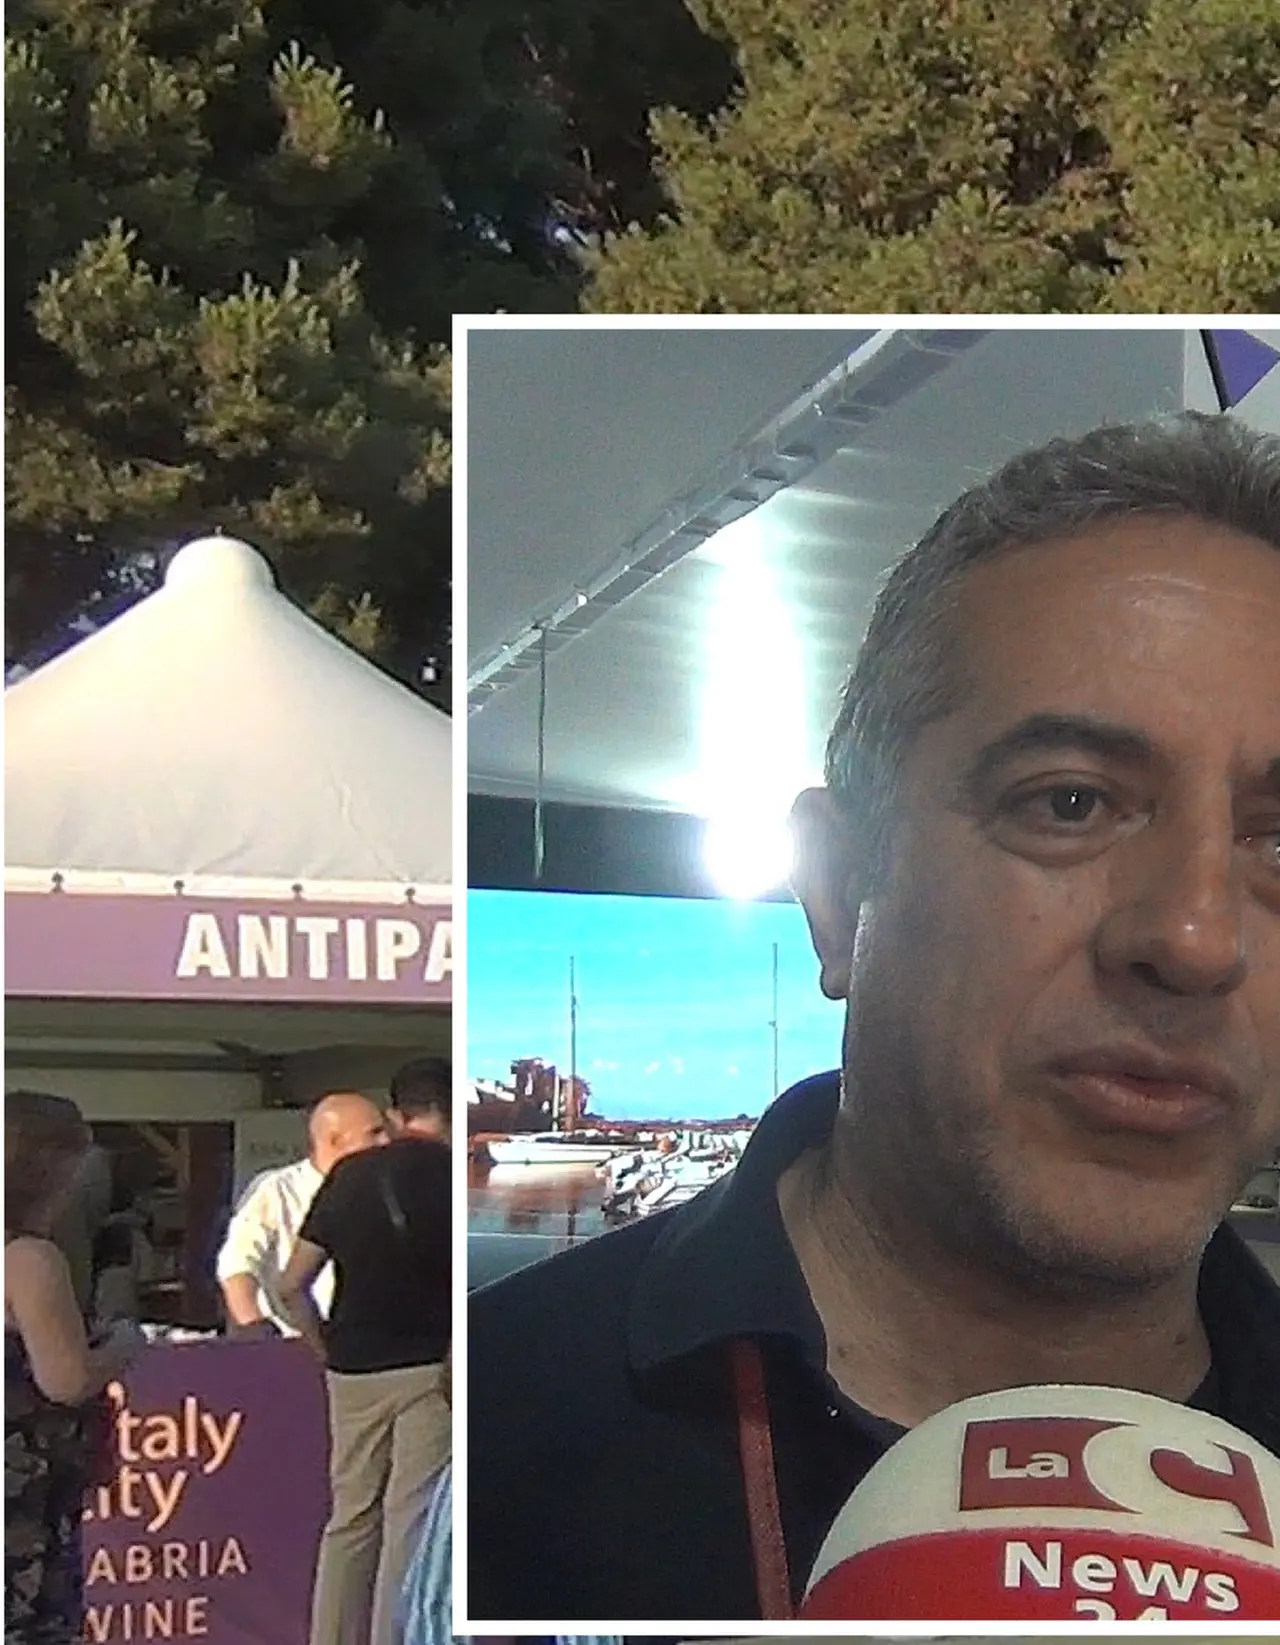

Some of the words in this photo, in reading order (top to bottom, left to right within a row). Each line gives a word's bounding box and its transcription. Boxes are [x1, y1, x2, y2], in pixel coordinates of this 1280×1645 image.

[82, 1462, 190, 1535] ity
[987, 1446, 1070, 1480] La
[1003, 1540, 1240, 1613] News
